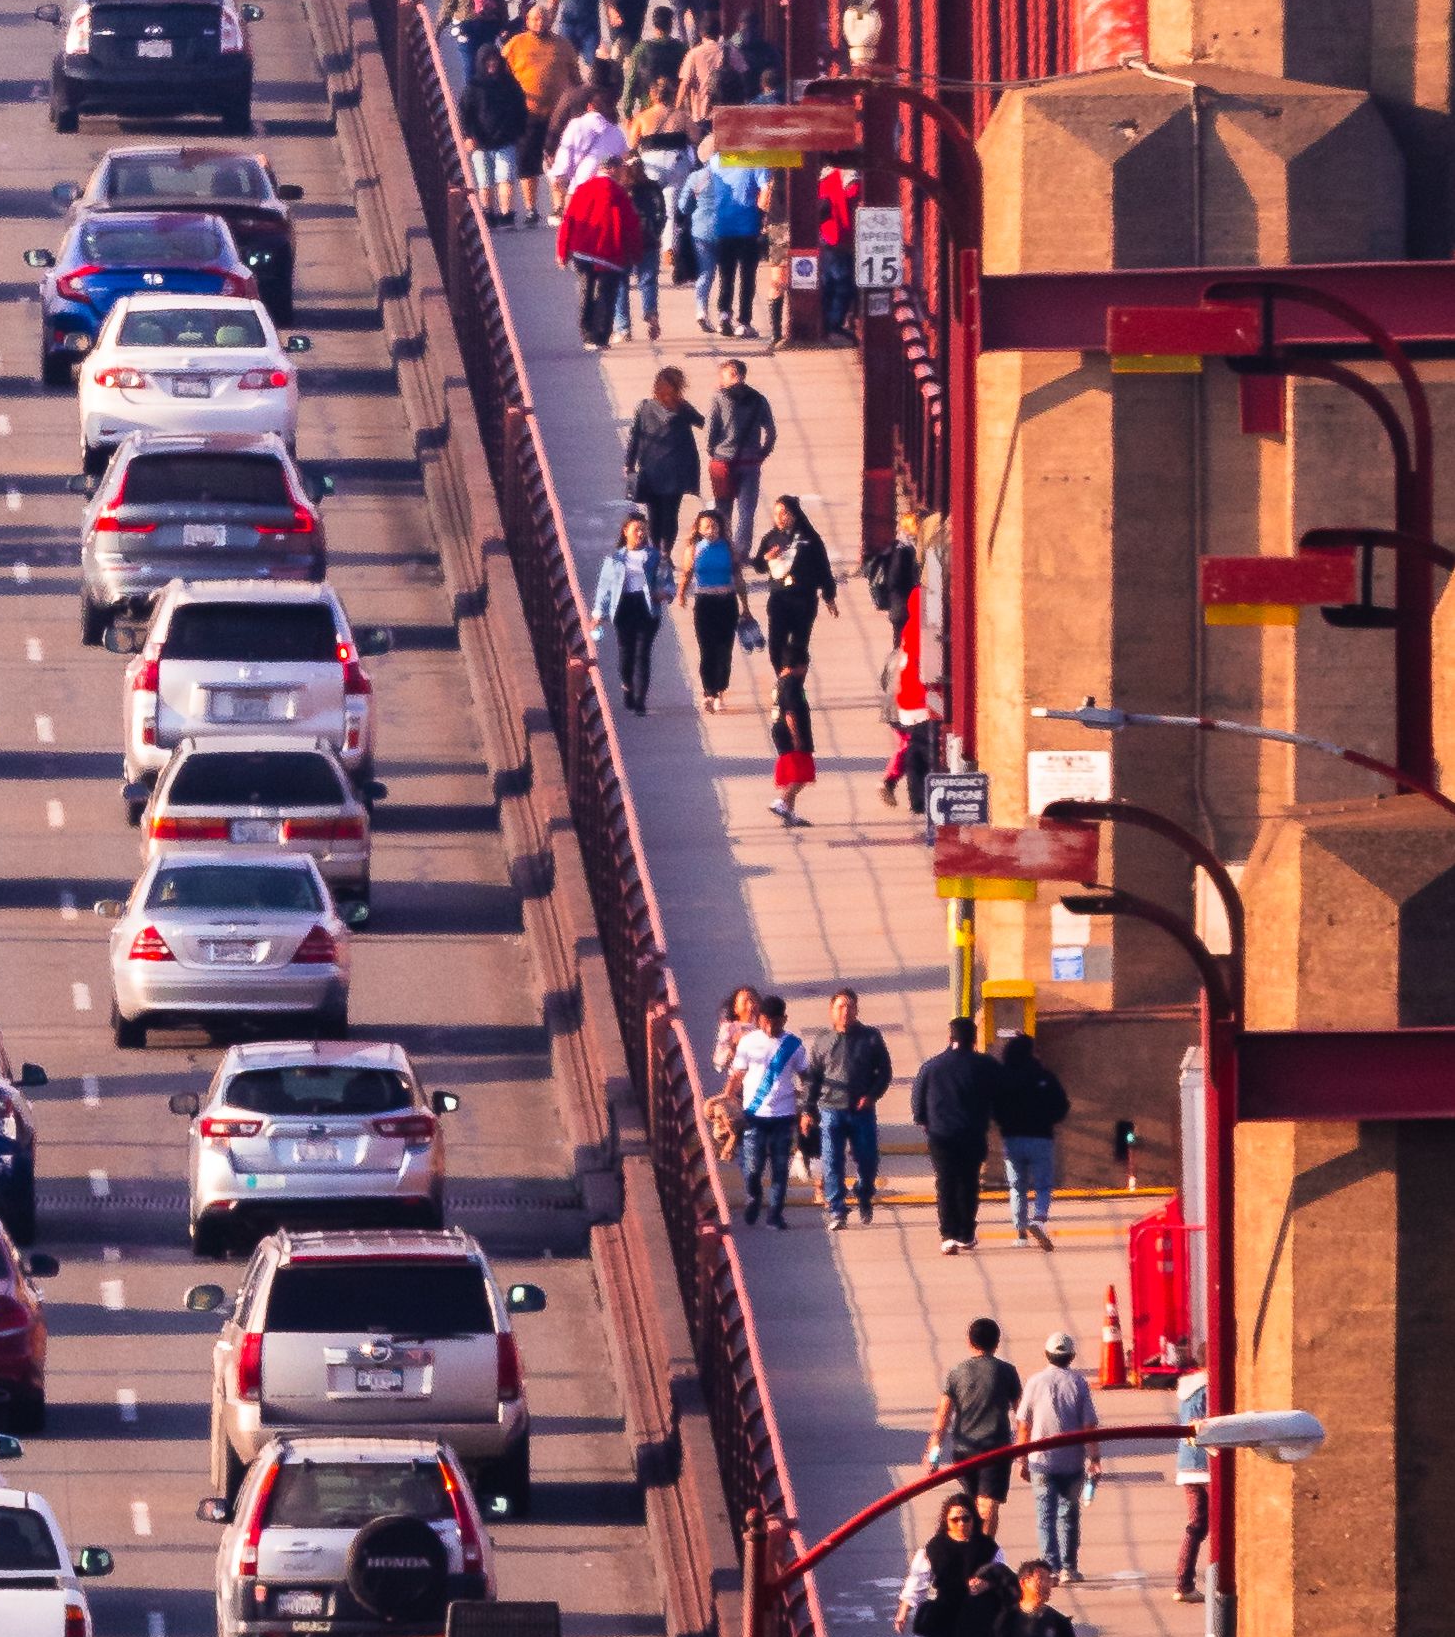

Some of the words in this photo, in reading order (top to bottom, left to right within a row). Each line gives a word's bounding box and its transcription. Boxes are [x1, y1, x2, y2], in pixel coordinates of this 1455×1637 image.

[862, 257, 898, 284] 15
[946, 790, 983, 801] PHONE
[951, 803, 980, 811] AND
[367, 1557, 432, 1568] HONDA
